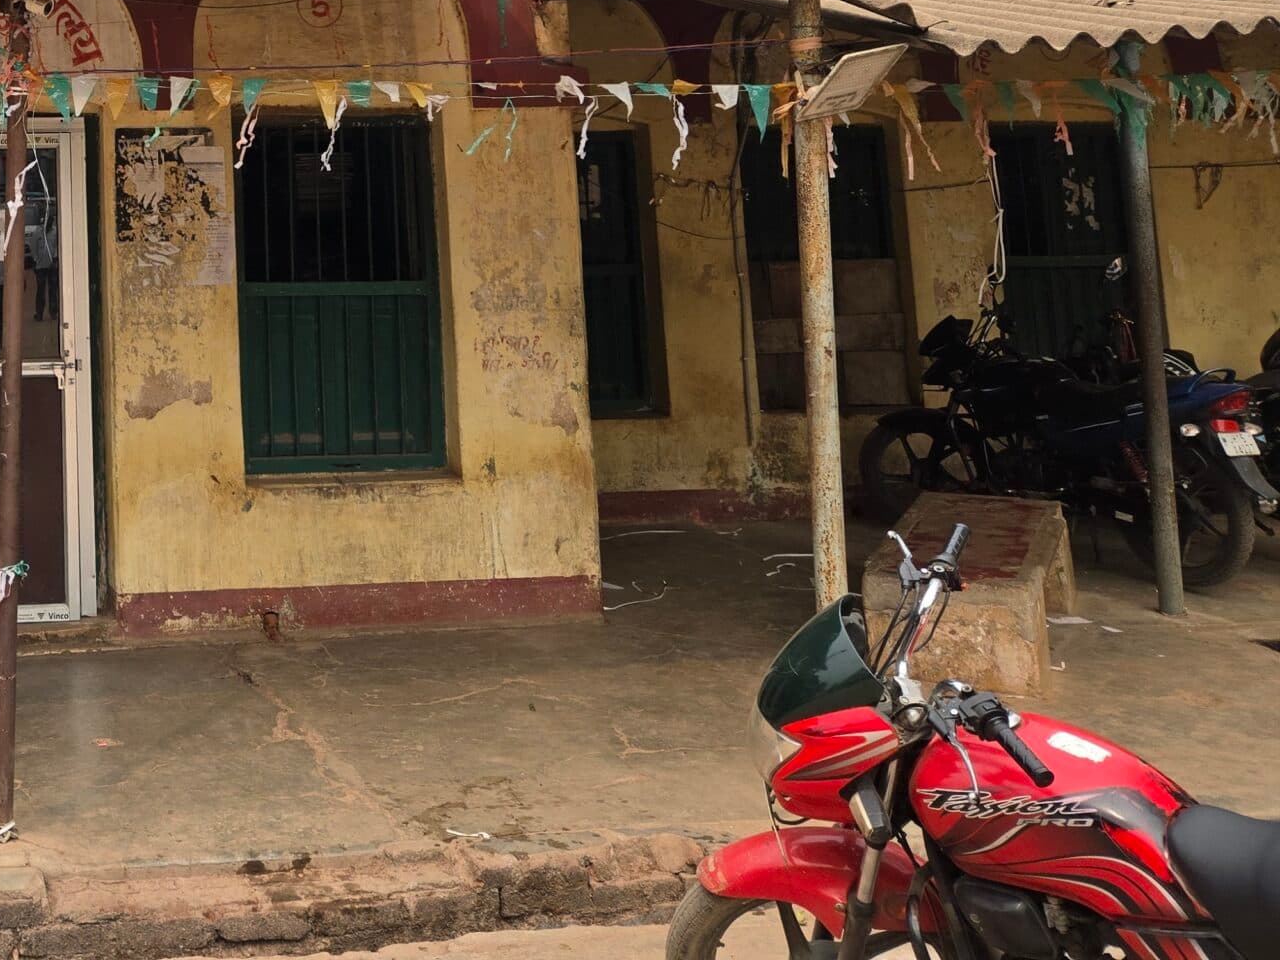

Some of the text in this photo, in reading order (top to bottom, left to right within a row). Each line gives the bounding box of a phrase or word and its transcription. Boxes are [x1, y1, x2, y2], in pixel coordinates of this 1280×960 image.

[48, 611, 70, 620] Vinco
[917, 788, 1098, 818] Passion
[1017, 817, 1094, 828] PRO
